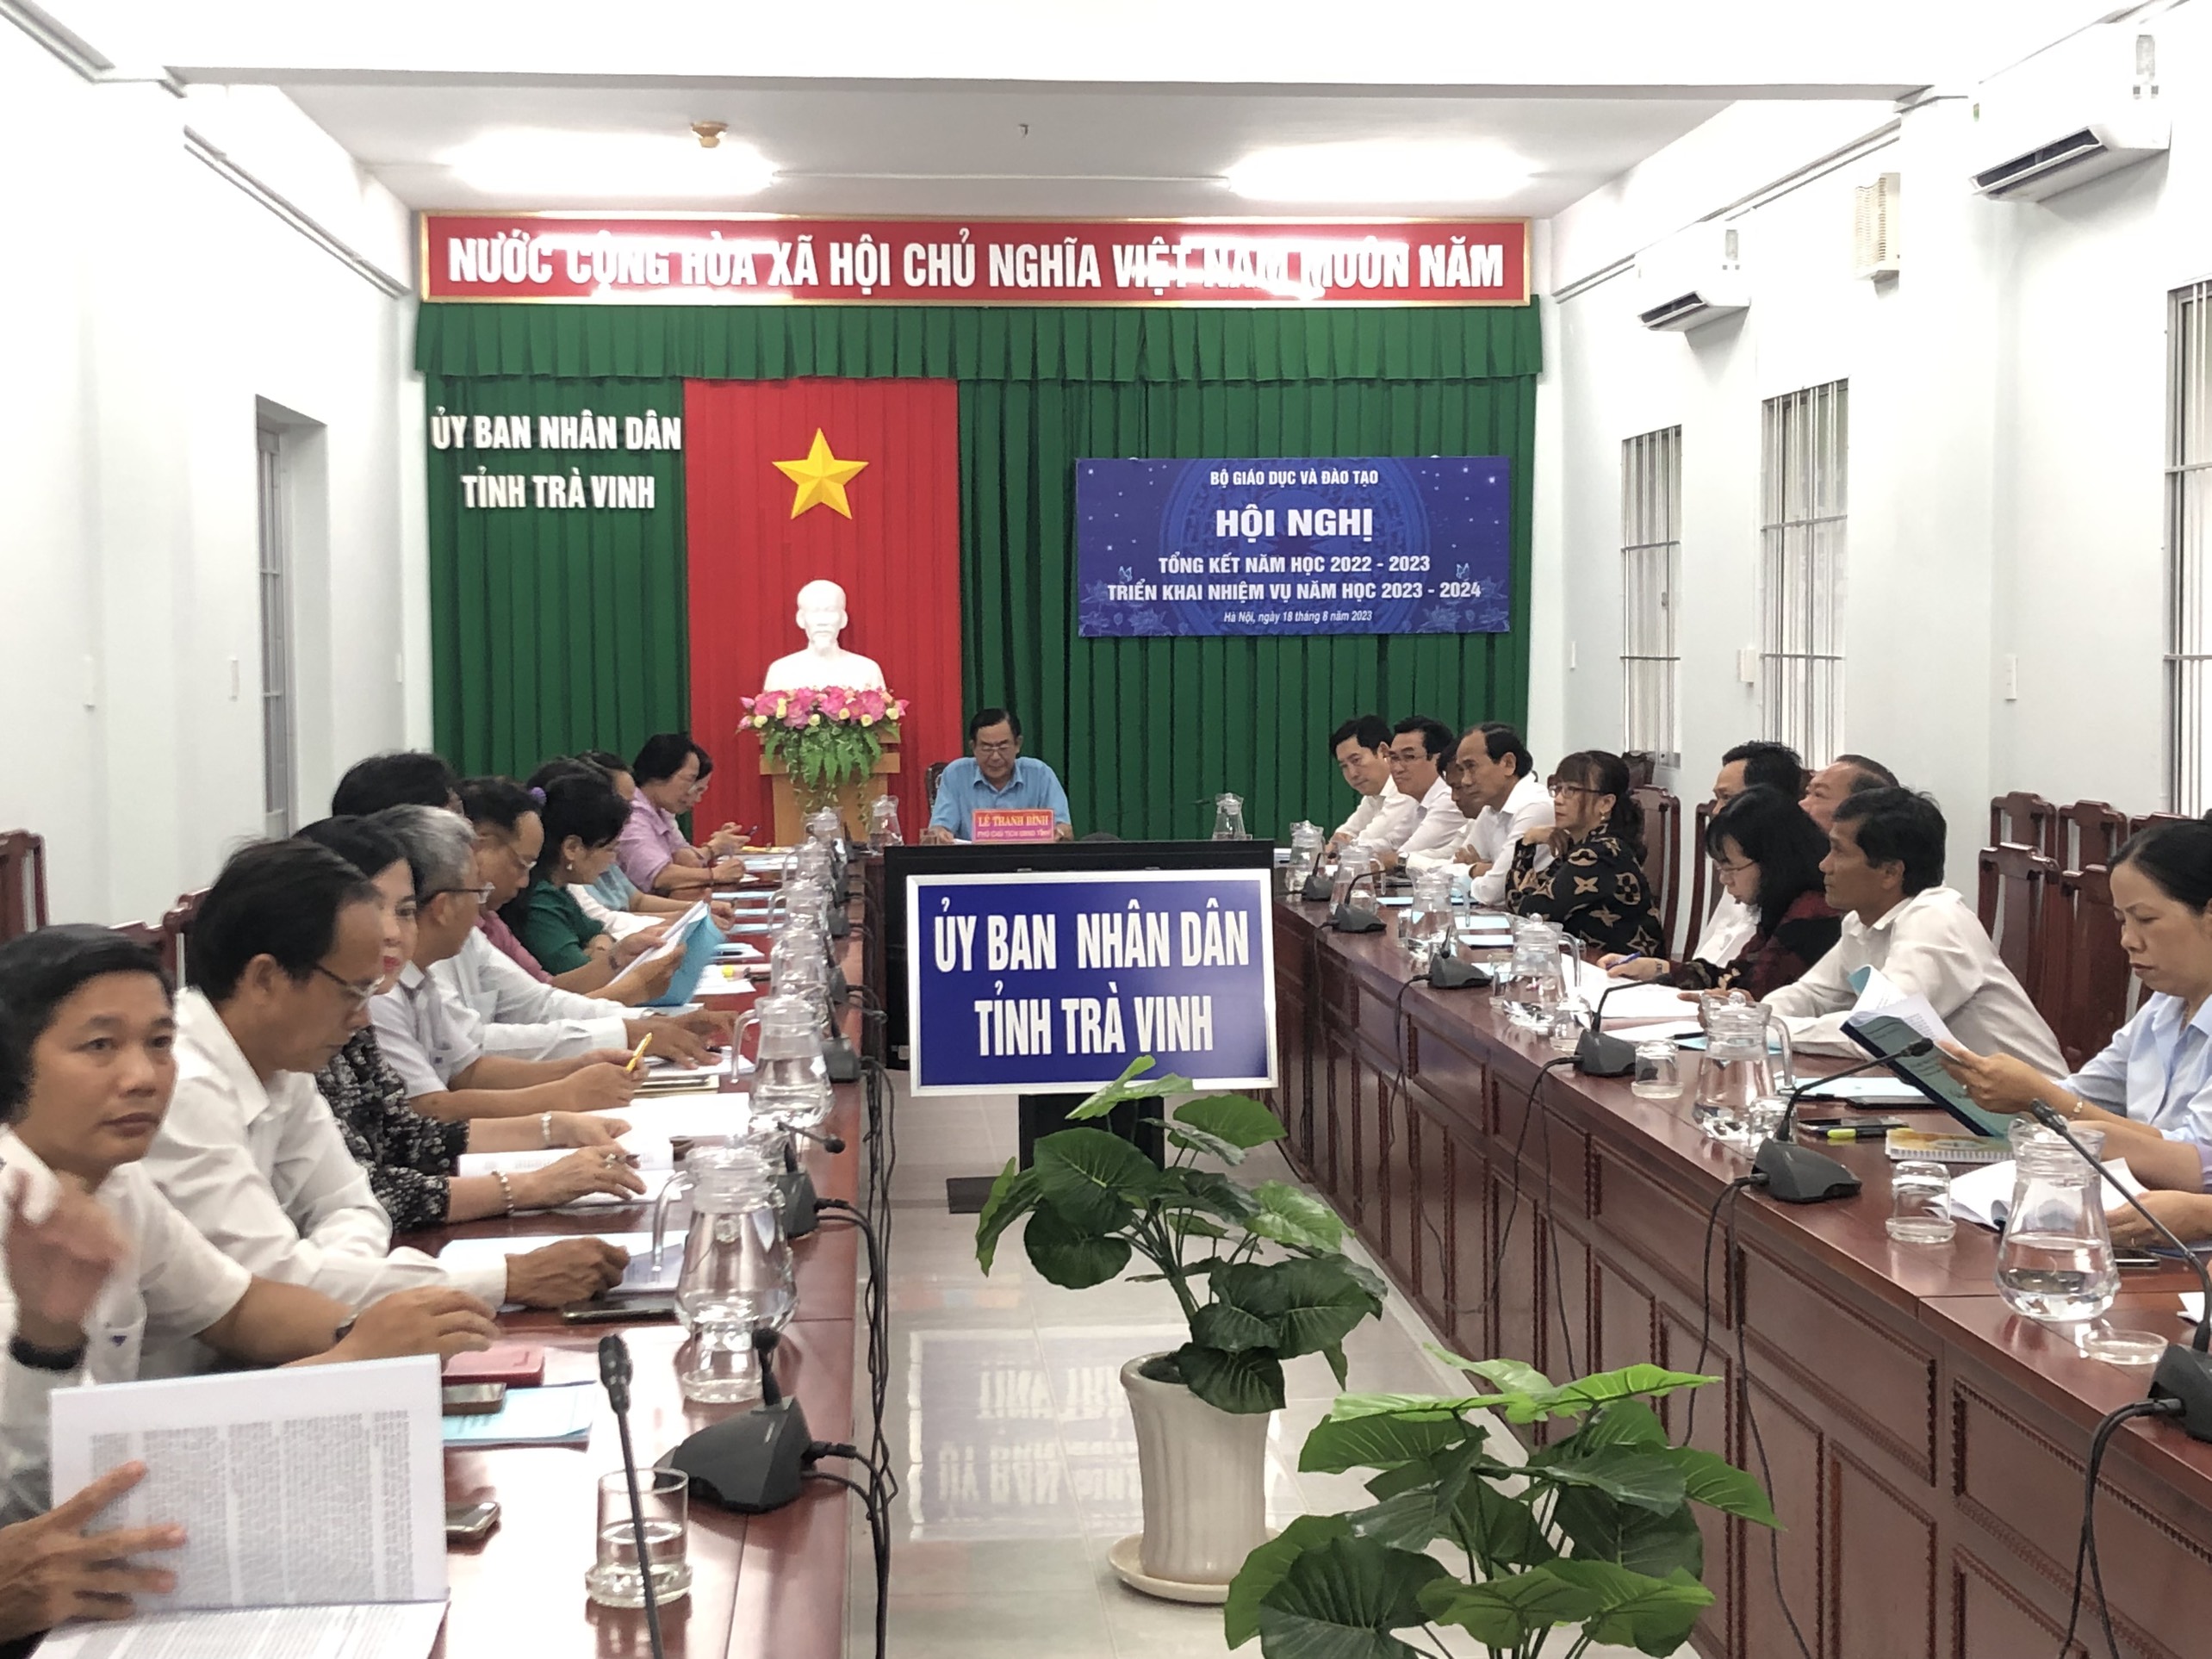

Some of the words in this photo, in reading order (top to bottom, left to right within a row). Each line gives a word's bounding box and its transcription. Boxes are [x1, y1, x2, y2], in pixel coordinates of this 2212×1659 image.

[448, 228, 553, 284] NƯỚC
[767, 234, 819, 286] XÃ
[830, 234, 891, 295] HỘI
[903, 227, 976, 288] CHỦ
[989, 237, 1102, 289] NGHĨA
[1112, 236, 1190, 296] VIỆT
[1203, 241, 1284, 289] NAM
[1419, 236, 1504, 289] NĂM
[431, 406, 468, 450] ỦY
[473, 414, 531, 450] BAN
[538, 408, 618, 450] NHÂN
[624, 408, 682, 450] DÂN
[461, 465, 526, 510] TỈNH
[531, 466, 587, 509] TRÀ
[590, 475, 656, 509] VINH
[1209, 469, 1230, 488] BỘ
[1233, 468, 1265, 486] GIÁO
[1269, 470, 1296, 488] DỤC
[1299, 468, 1319, 485] VÀ
[1320, 468, 1349, 485] ĐÀO
[1351, 469, 1379, 487] TẠO
[1215, 503, 1275, 544] HỘI
[1287, 507, 1373, 542] NGHỊ
[1159, 550, 1204, 575] TỔNG
[1209, 551, 1240, 574] KẾT
[1245, 552, 1286, 574] NĂM
[1290, 555, 1325, 575] HỌC
[1330, 555, 1372, 573] 2022
[1389, 555, 1431, 572] 2023
[1107, 579, 1158, 602] TRIỂN
[1162, 584, 1203, 601] KHAI
[1208, 580, 1264, 604] NHIỆM
[1269, 583, 1292, 604] VỤ
[1296, 580, 1337, 600] NĂM
[1341, 582, 1376, 603] HỌC
[1381, 581, 1423, 600] 2023
[1439, 581, 1482, 599] 2024
[1223, 611, 1237, 623] Hà
[1238, 610, 1256, 624] Nội,
[1258, 612, 1281, 625] ngày
[1282, 611, 1293, 623] 18
[1295, 610, 1320, 624] tháng
[1322, 610, 1328, 622] 8
[1330, 610, 1350, 622] năm
[1351, 610, 1372, 622] 2023
[992, 815, 1024, 827] THANH
[935, 896, 977, 972] ỦY
[987, 913, 1057, 971] BAN
[1077, 898, 1170, 969] NHÂN
[1180, 897, 1249, 967] DÂN
[974, 979, 1052, 1057] TỈNH
[1060, 980, 1126, 1054] TRÀ
[1134, 995, 1214, 1053] VINH
